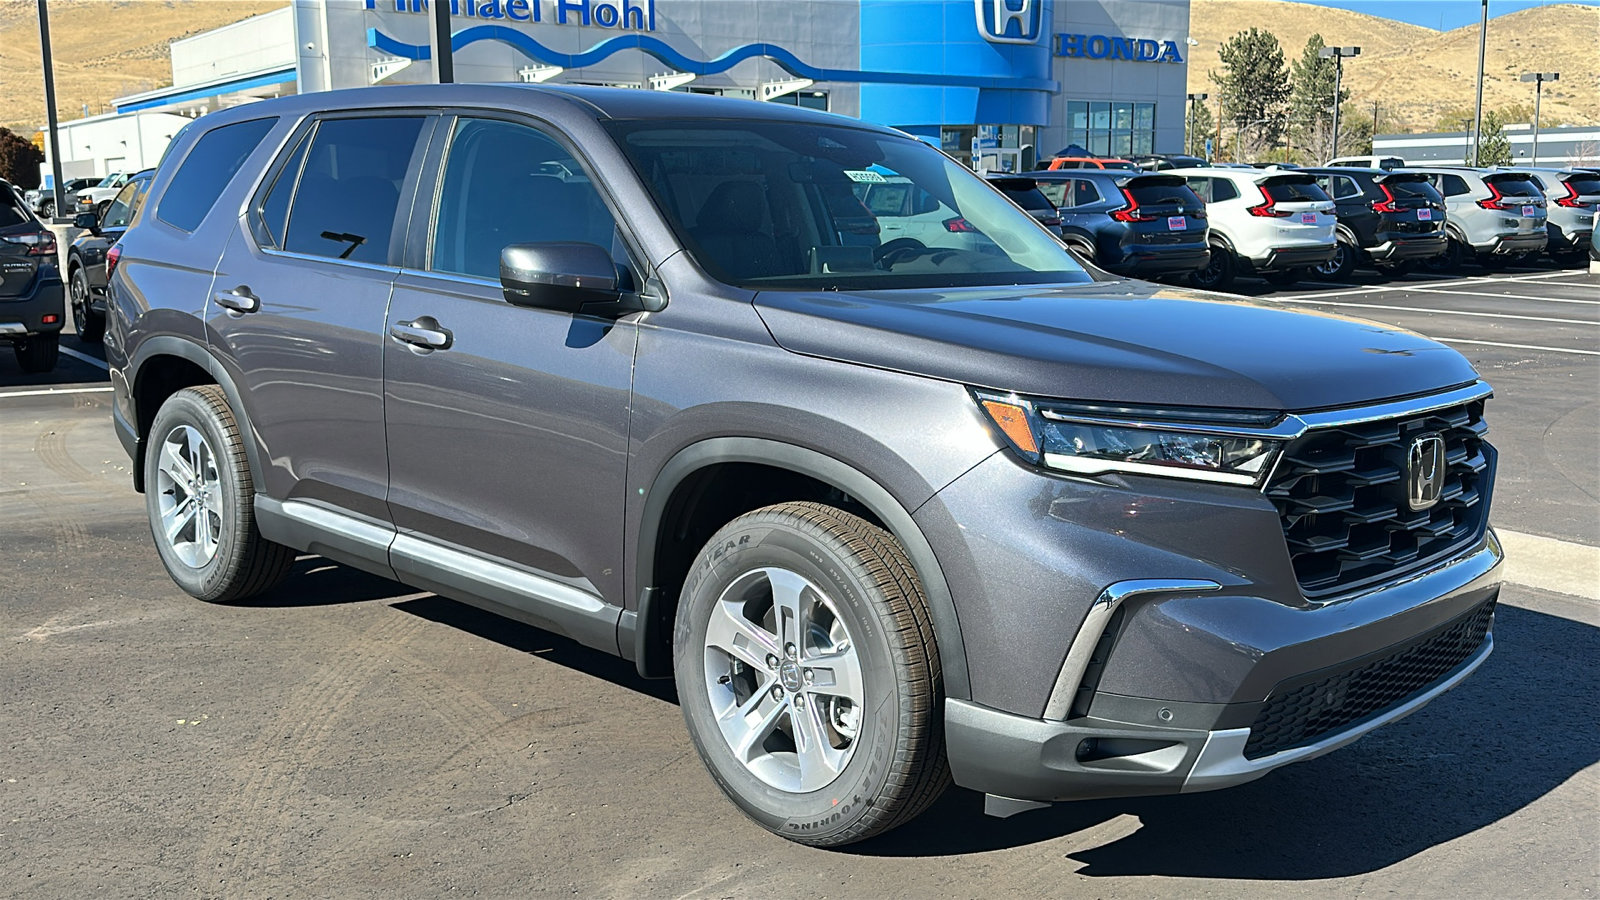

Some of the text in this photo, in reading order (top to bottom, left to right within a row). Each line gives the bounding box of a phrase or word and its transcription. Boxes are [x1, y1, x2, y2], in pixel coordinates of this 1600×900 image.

[363, 0, 656, 31] hael Hohl
[1054, 33, 1184, 63] HONDA
